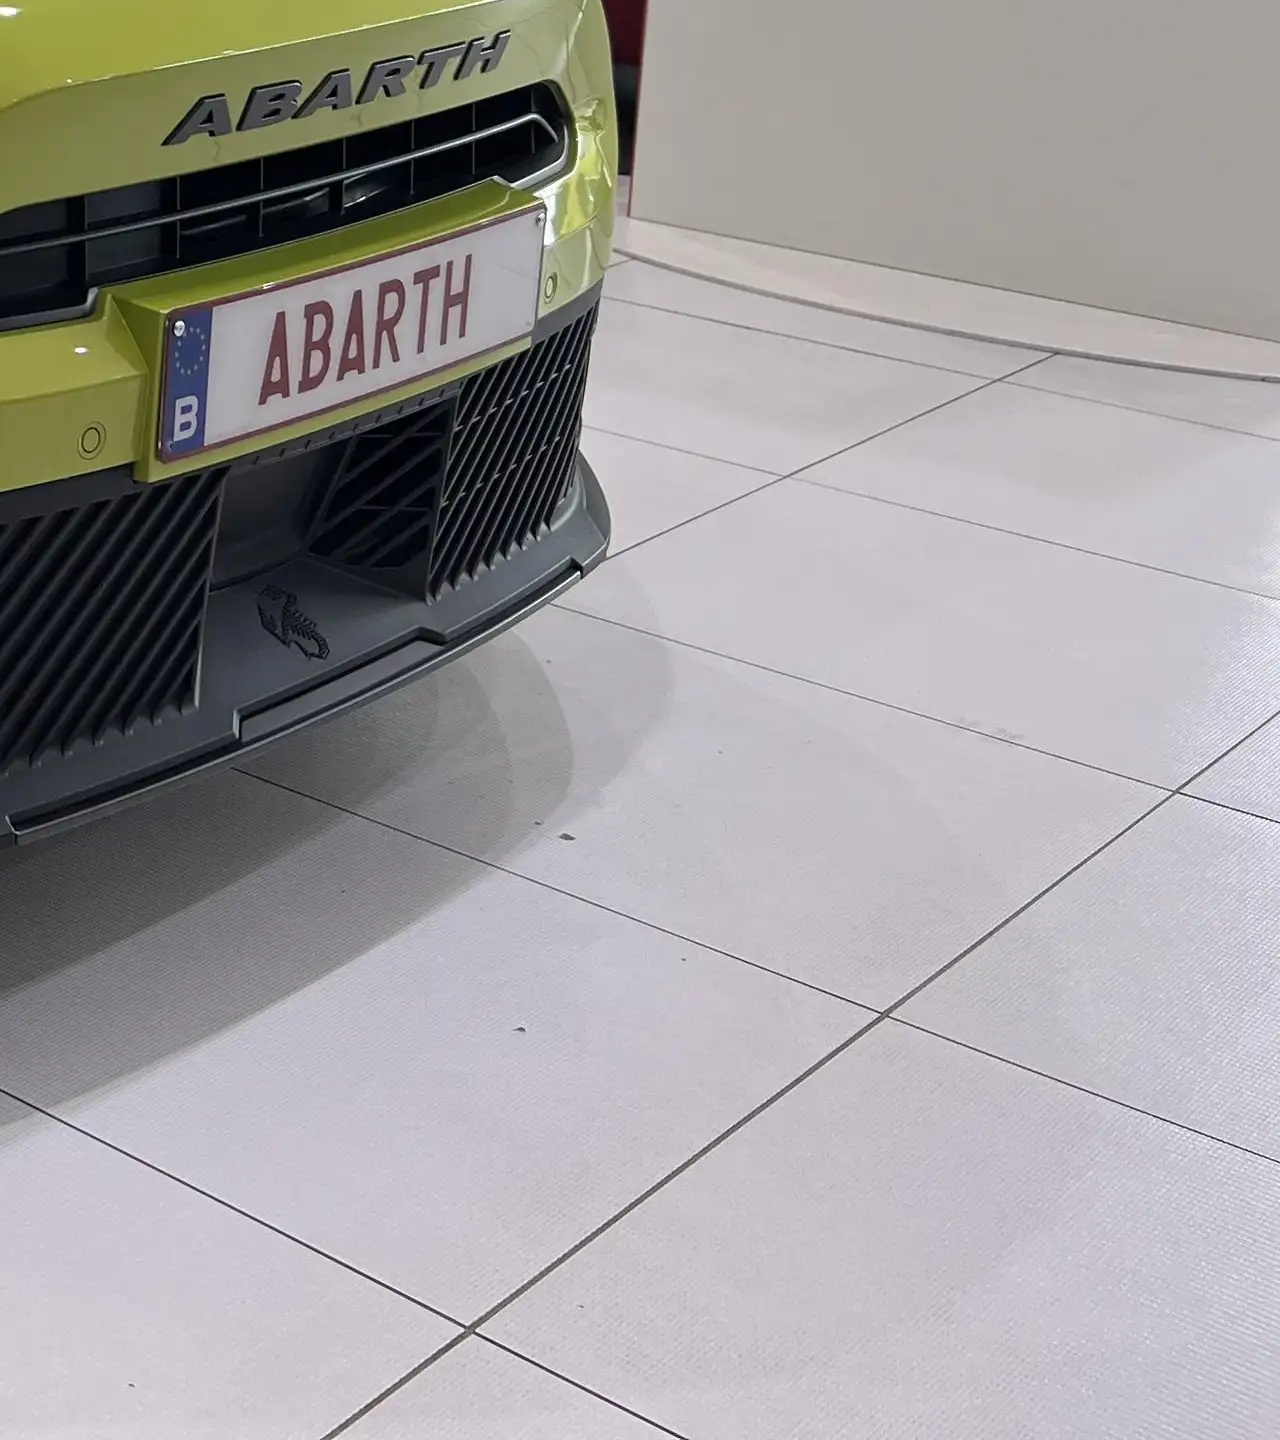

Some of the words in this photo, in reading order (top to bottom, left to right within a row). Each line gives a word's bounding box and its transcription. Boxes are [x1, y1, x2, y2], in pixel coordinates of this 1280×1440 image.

[160, 30, 511, 146] ABARTH
[258, 253, 473, 406] ABARTH
[172, 394, 199, 443] B
